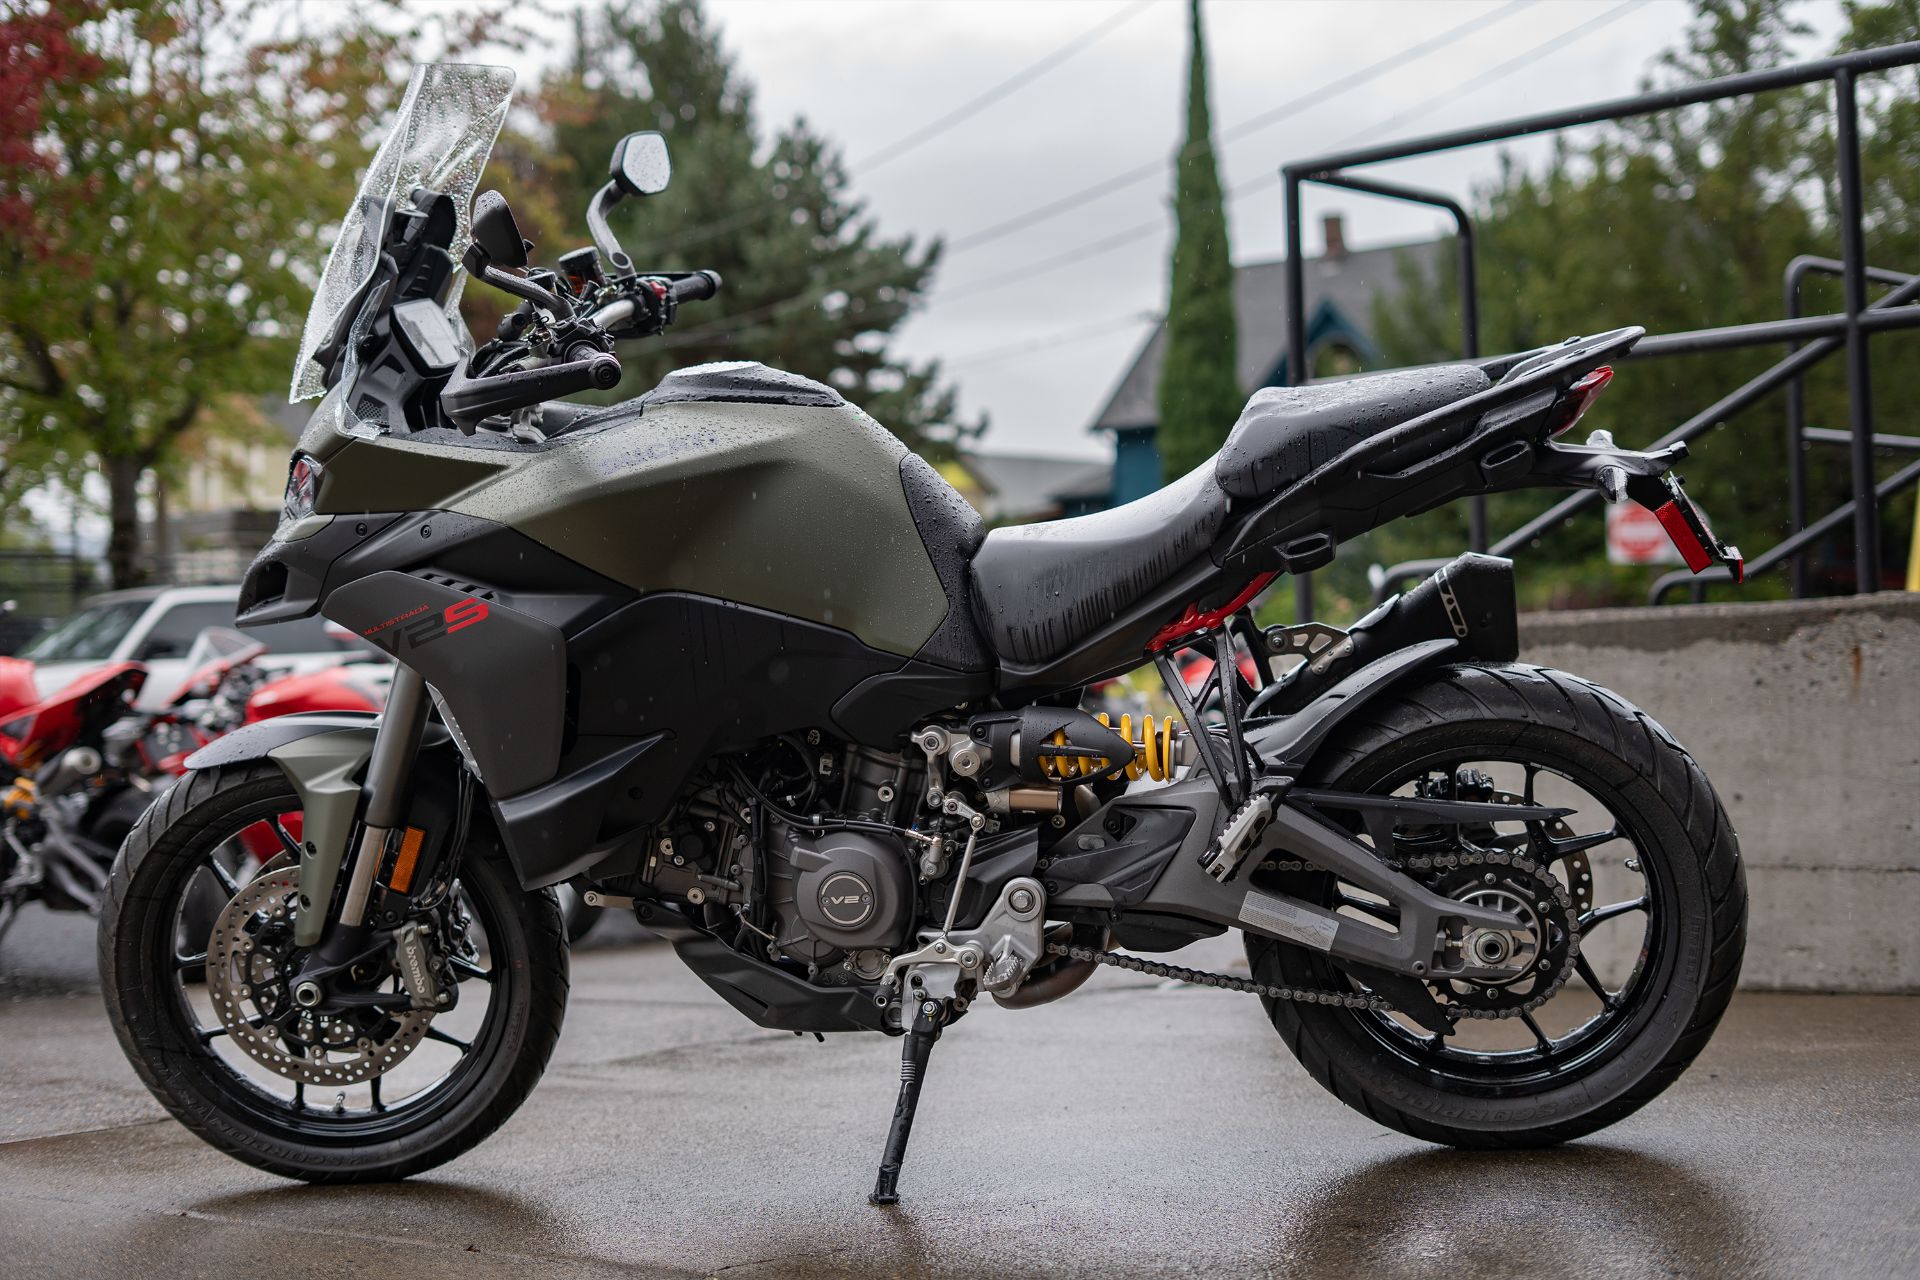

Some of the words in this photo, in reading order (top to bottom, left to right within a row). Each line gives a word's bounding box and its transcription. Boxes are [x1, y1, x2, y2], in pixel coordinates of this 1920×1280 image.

[363, 603, 430, 636] MULTISTRADA
[830, 895, 860, 905] V2
[405, 945, 426, 994] brembo
